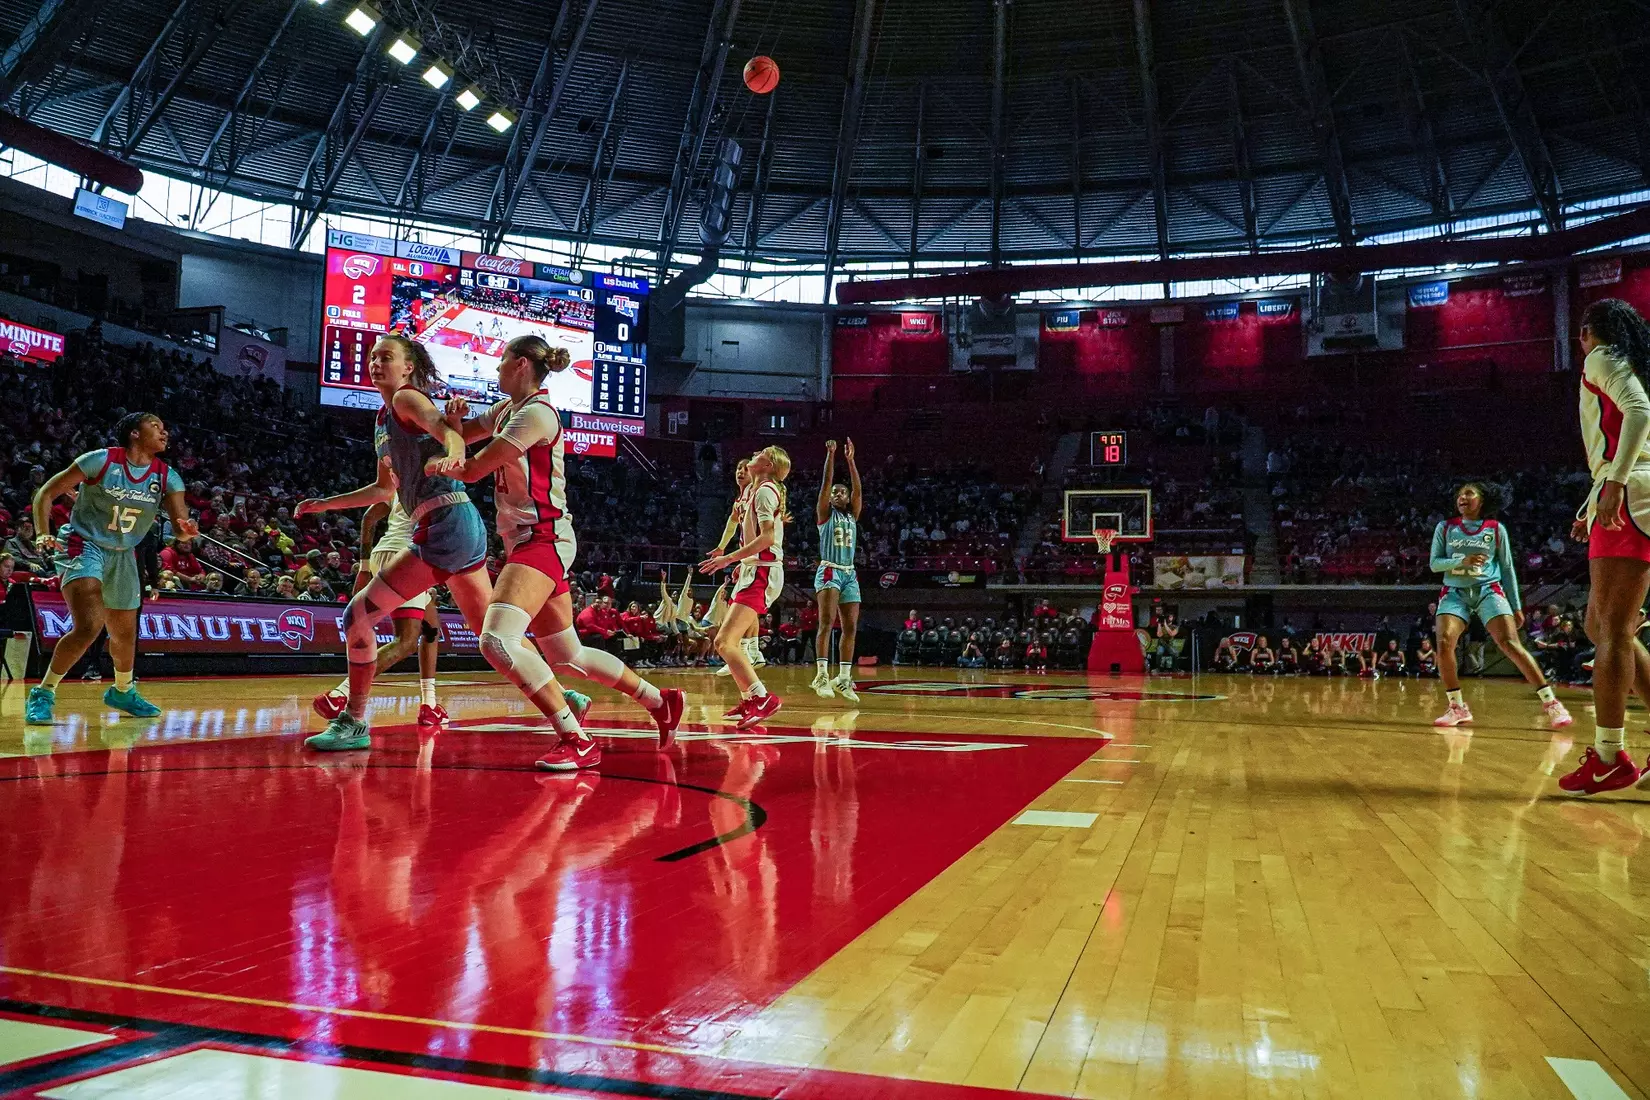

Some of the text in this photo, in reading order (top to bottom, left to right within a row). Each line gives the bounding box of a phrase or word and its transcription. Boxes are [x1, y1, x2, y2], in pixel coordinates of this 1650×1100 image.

[409, 244, 440, 256] LOGAN
[406, 253, 437, 262] ALUMINUM
[475, 254, 522, 275] Coca-Cola
[543, 266, 570, 277] CHEETAH
[487, 275, 509, 289] 9:07
[553, 274, 569, 282] Clean
[352, 285, 366, 305] 2
[1259, 303, 1291, 313] LIBERTY
[0, 322, 62, 353] MINUTE
[335, 330, 340, 339] 1
[356, 332, 362, 341] 0
[617, 323, 629, 341] 0
[334, 340, 362, 352] 3 0
[332, 351, 361, 362] 10 0
[330, 361, 361, 372] 23 0
[603, 364, 608, 372] 3
[619, 366, 625, 374] 0
[354, 374, 360, 383] 0
[619, 375, 624, 384] 0
[635, 377, 640, 386] 0
[618, 384, 624, 393] 0
[634, 386, 640, 395] 0
[618, 394, 624, 402] 0
[634, 396, 640, 404] 0
[618, 403, 624, 412] 0
[634, 405, 639, 414] 0
[572, 415, 644, 434] Budweiser
[1104, 445, 1120, 462] 18
[105, 486, 128, 501] Lady
[108, 505, 142, 534] 15
[38, 608, 307, 642] MINUTE WKU
[1234, 635, 1249, 644] WKU
[1315, 632, 1376, 653] WKU
